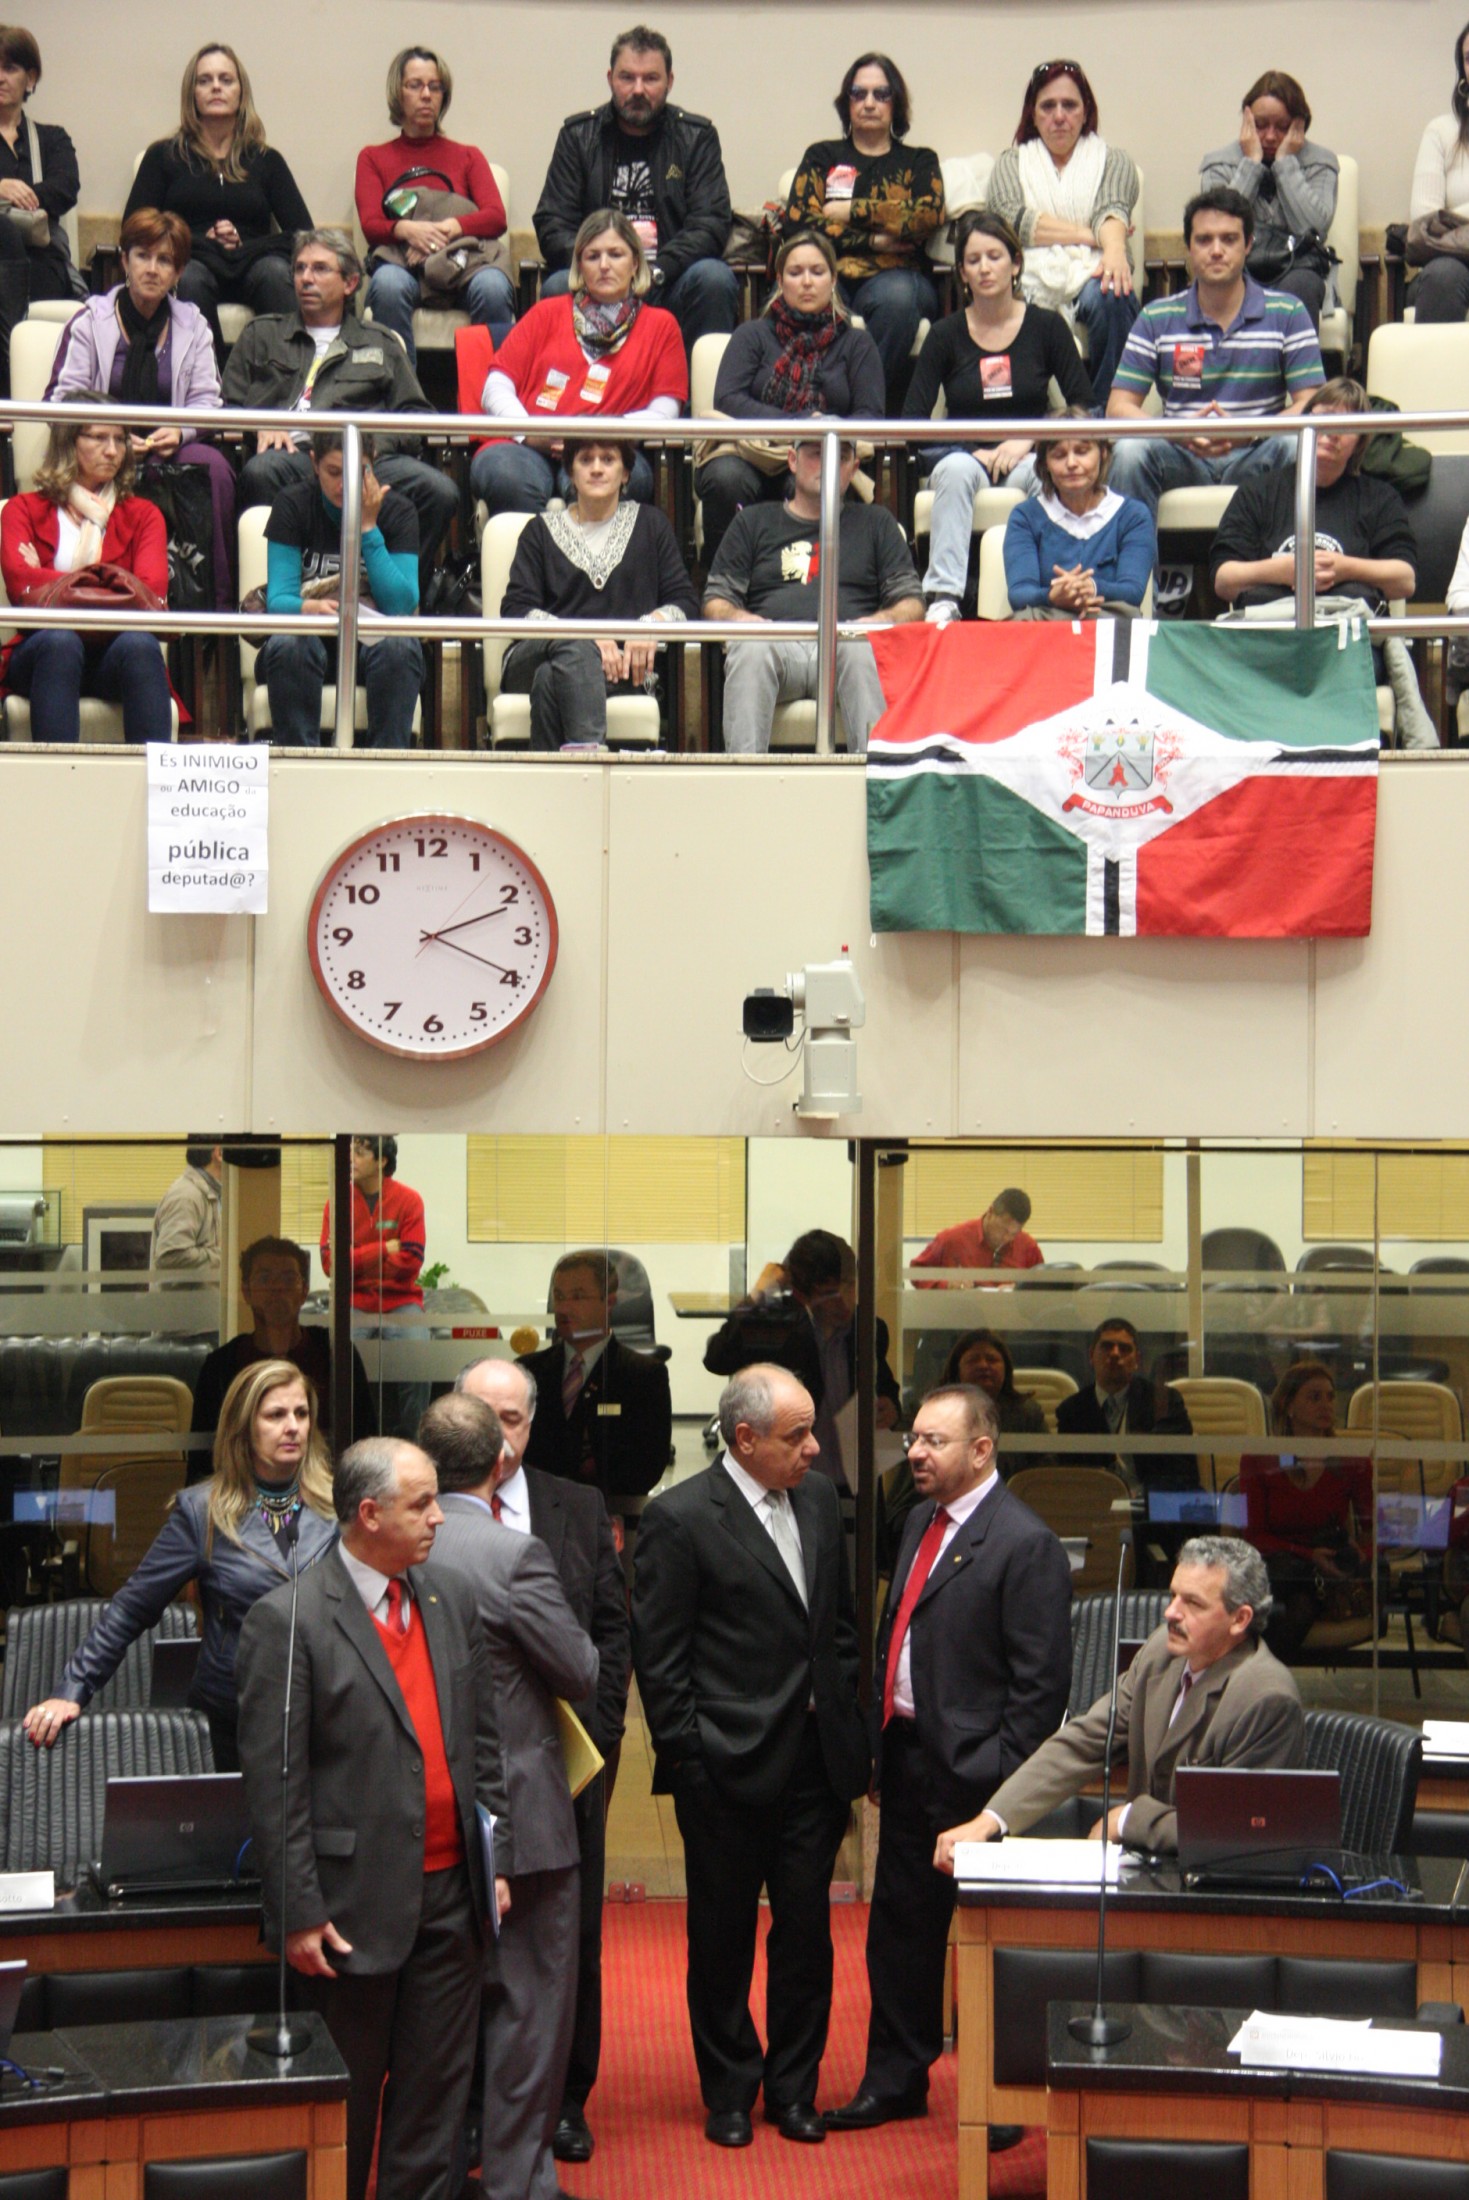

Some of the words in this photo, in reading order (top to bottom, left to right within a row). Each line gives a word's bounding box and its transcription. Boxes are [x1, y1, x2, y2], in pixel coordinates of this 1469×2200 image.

[160, 751, 177, 768] És
[183, 754, 258, 770] INIMIGO
[160, 785, 172, 793] ou
[177, 779, 240, 794] AMIGO
[170, 803, 247, 820] educação
[1081, 800, 1155, 818] PAPANDUVA
[168, 839, 249, 862] pública
[414, 838, 448, 858] 12
[376, 853, 400, 872] 11
[469, 853, 480, 871] 1
[161, 871, 255, 888] deputad@?
[345, 884, 380, 905] 10
[499, 885, 519, 904] 2
[332, 927, 353, 947] 9
[513, 926, 533, 946] 3
[346, 970, 366, 990] 8
[499, 969, 521, 988] 4
[383, 1002, 403, 1021] 7
[469, 1002, 487, 1021] 5
[423, 1014, 444, 1033] 6
